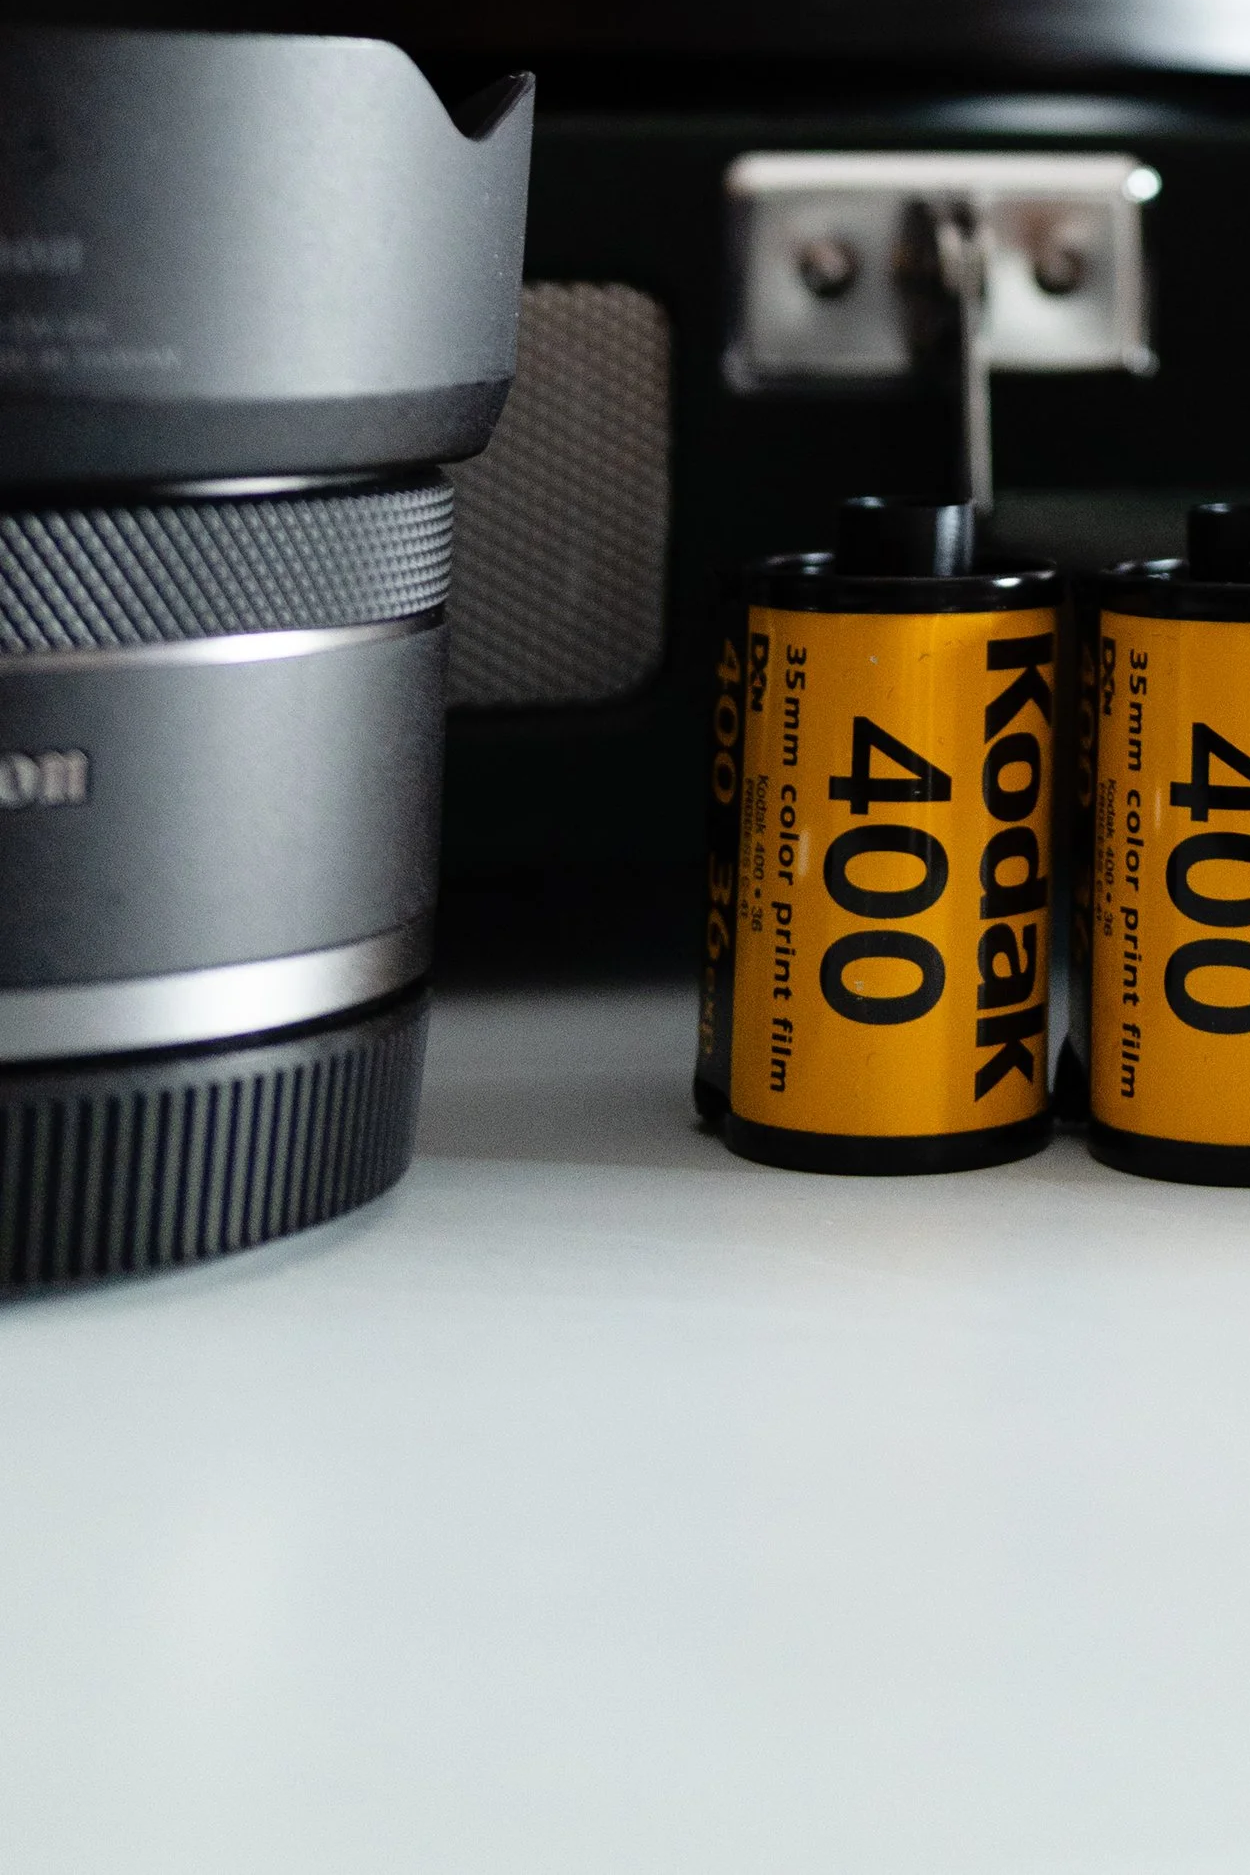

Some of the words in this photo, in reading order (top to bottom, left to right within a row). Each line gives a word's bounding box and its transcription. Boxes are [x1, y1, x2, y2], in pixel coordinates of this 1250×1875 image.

[782, 645, 806, 766] 35mm
[1128, 649, 1148, 771] 35mm
[777, 785, 800, 885] color
[820, 716, 952, 1025] 400
[975, 632, 1054, 1101] Kodak
[1126, 789, 1145, 891] color
[771, 901, 796, 998] print
[1120, 906, 1143, 1005] print
[770, 1017, 792, 1093] film
[1120, 1023, 1141, 1099] film
